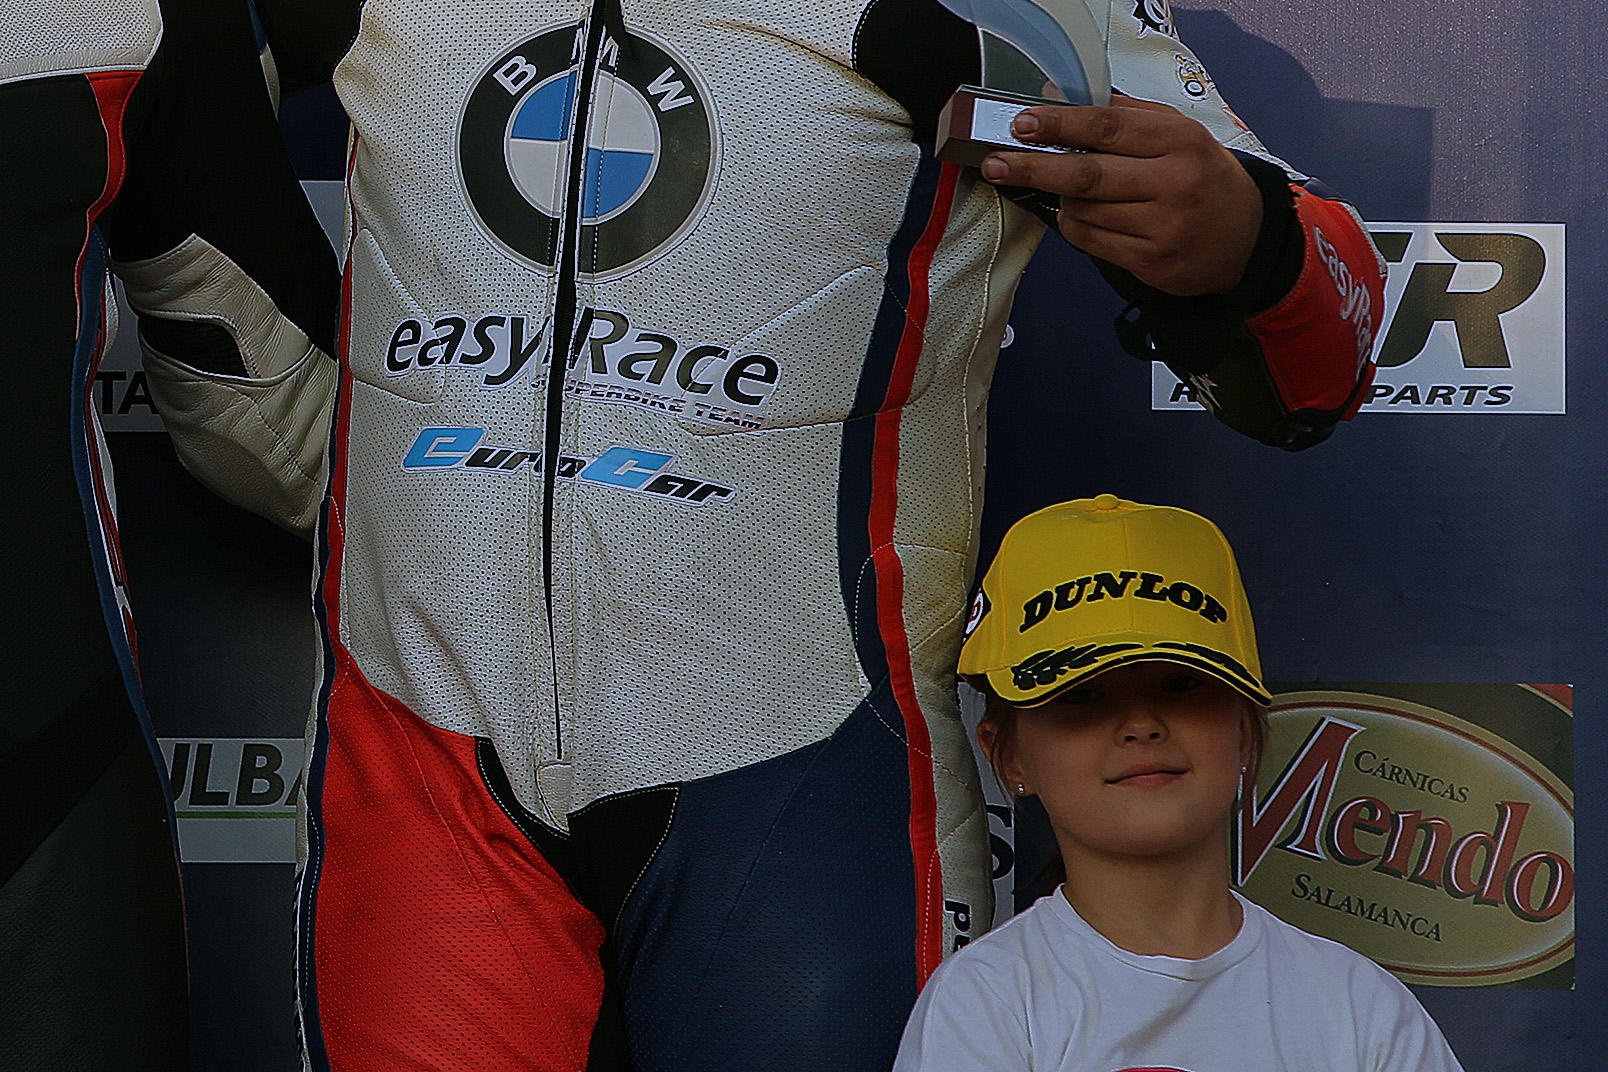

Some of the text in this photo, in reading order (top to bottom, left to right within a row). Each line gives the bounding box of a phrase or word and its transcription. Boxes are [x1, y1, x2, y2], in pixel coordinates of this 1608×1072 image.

[387, 307, 780, 406] easyRace
[694, 402, 766, 429] TEAM
[1367, 385, 1513, 406] PARTS
[1019, 571, 1228, 632] DUNLOP
[1353, 750, 1469, 804] CÁRNICAS
[1235, 716, 1574, 923] Mendo
[1291, 873, 1443, 942] SALAMANCA
